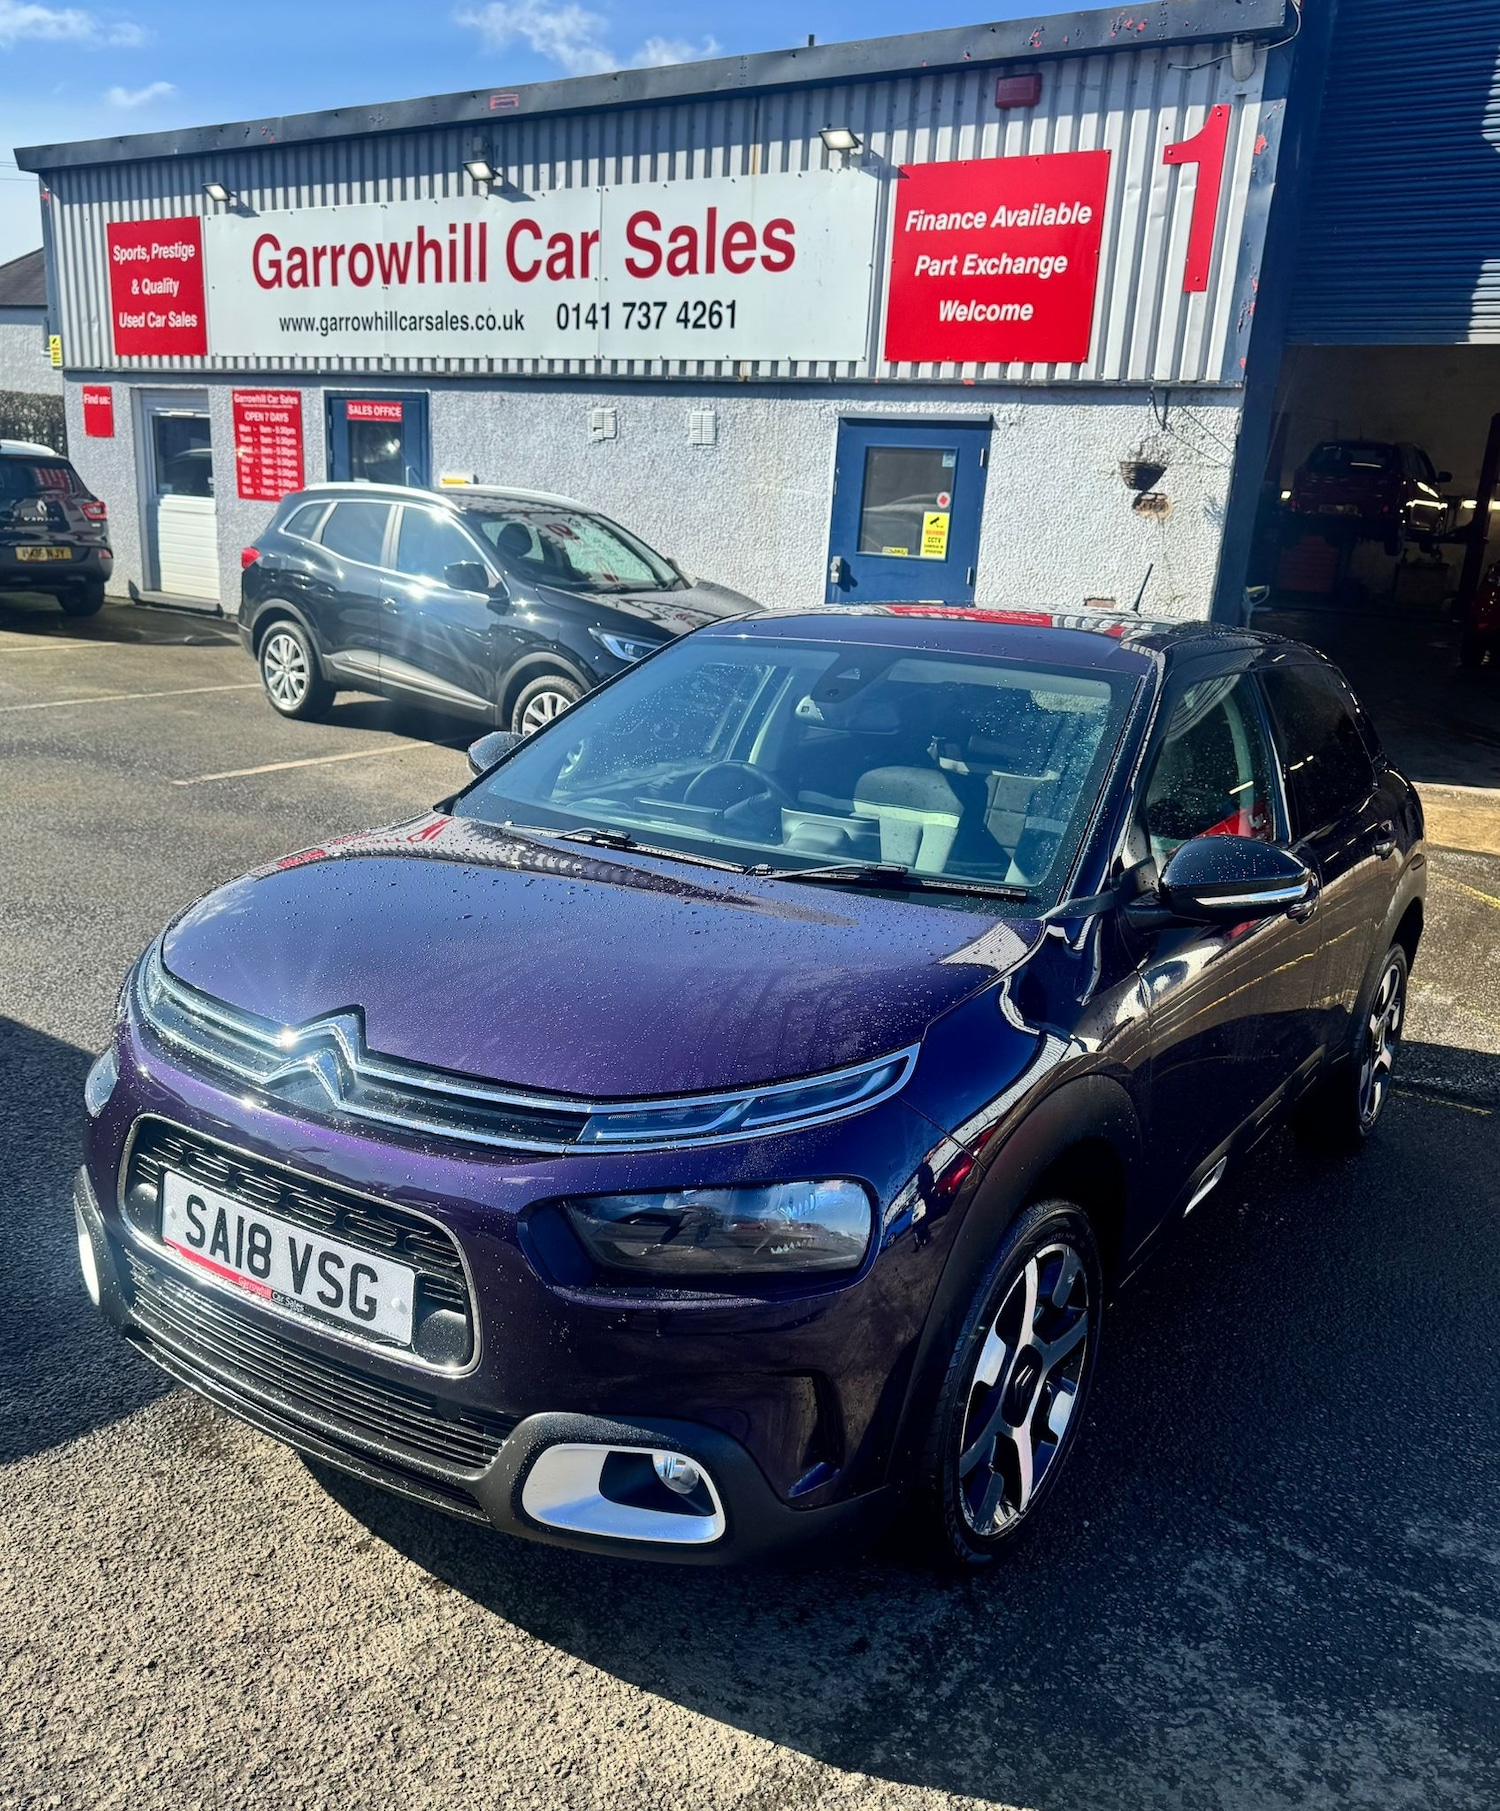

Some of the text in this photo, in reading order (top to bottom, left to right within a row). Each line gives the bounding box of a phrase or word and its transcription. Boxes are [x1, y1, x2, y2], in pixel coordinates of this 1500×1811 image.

[1162, 103, 1231, 292] 1
[905, 201, 1093, 232] Finance Available
[113, 241, 195, 265] Sports, Prestige
[252, 206, 796, 290] Garrowhill Car Sales
[914, 252, 1069, 280] Part Exchange
[131, 277, 180, 298] & Quality
[119, 310, 198, 328] Used Car Sales
[279, 309, 526, 337] www.garrowhillcarsales.co.uk
[556, 299, 737, 331] 0141 737 4261
[938, 300, 1034, 323] Welcome
[83, 393, 99, 405] Find
[267, 394, 280, 405] Car
[280, 394, 299, 405] Sales
[347, 403, 402, 418] SALES OFFICE
[244, 411, 264, 422] OPEN
[270, 412, 290, 423] DAYS
[185, 1194, 379, 1322] SA18 VSG
[285, 1296, 305, 1312] Sales
